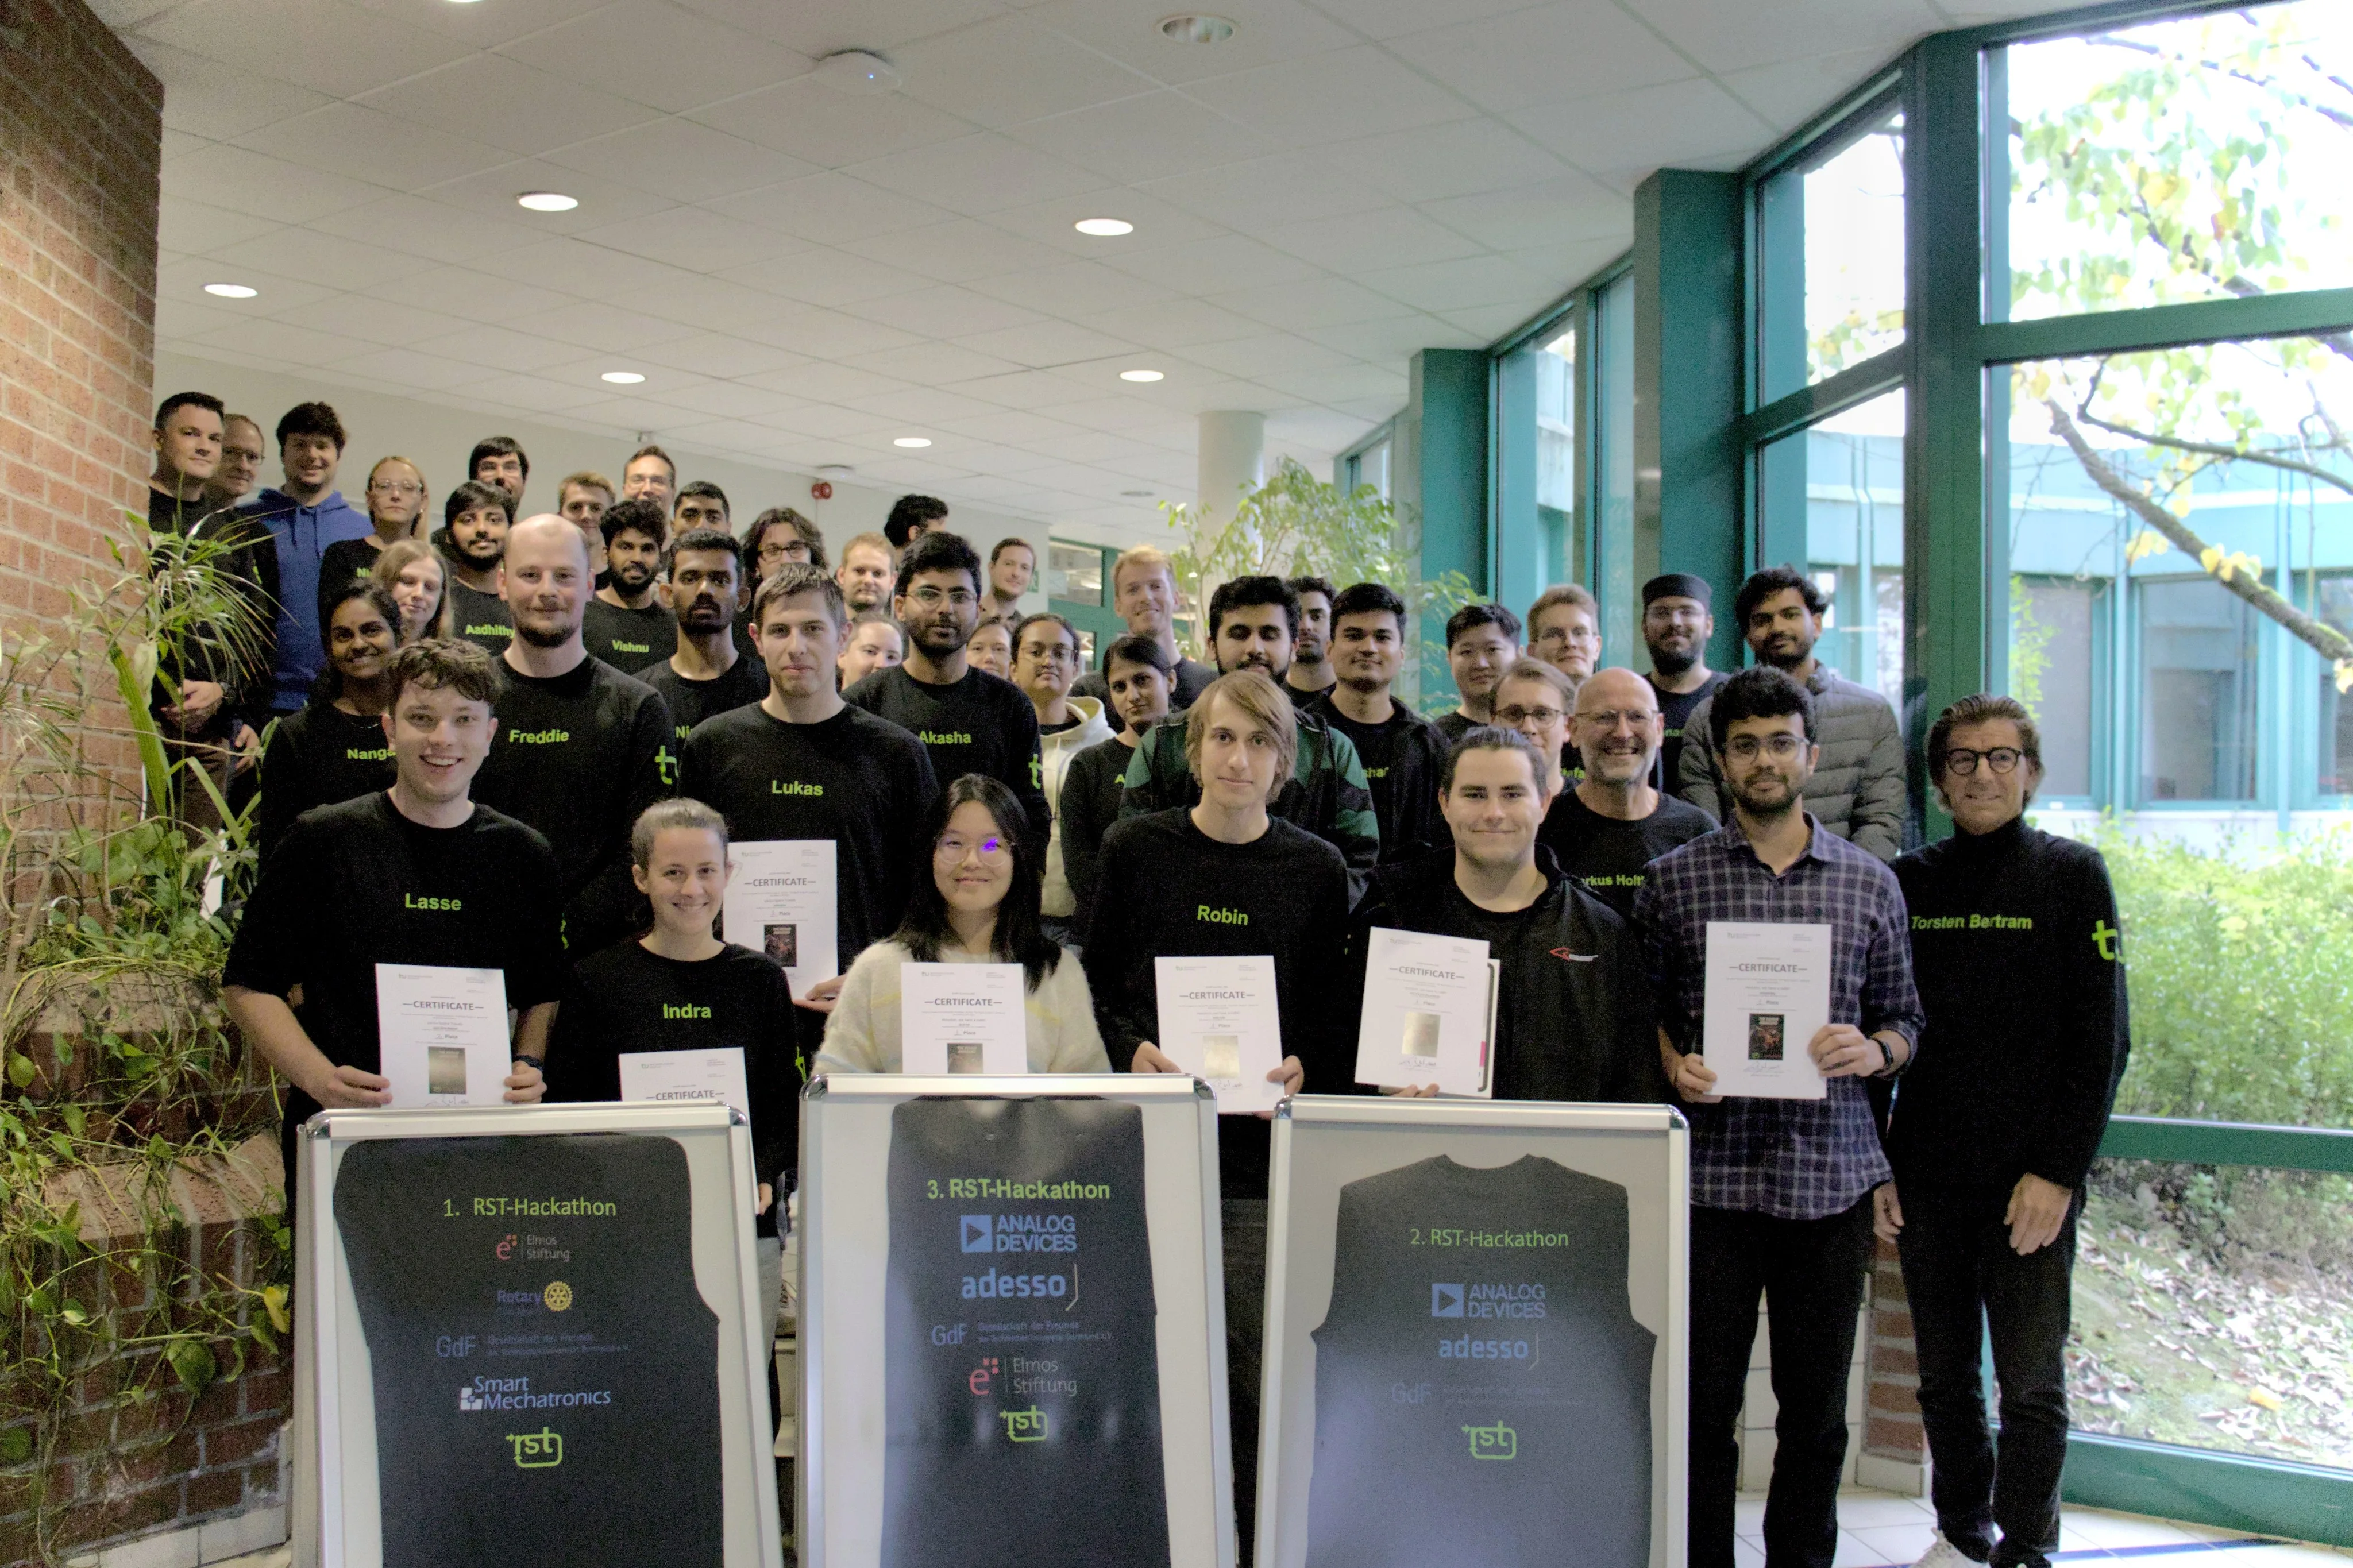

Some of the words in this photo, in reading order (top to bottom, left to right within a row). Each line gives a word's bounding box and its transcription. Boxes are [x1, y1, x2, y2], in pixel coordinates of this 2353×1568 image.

[465, 624, 515, 639] Aadhithy
[612, 640, 649, 653] Vishnu
[509, 729, 569, 744] Freddie
[919, 731, 971, 744] Akasha
[346, 748, 396, 760] Nanga
[772, 780, 824, 797] Lukas
[753, 878, 807, 887] CERTIFICATE
[405, 893, 461, 910] Lasse
[1197, 905, 1248, 925] Robin
[1912, 916, 1965, 930] Torsten
[1969, 913, 2032, 930] Bertram
[1398, 965, 1457, 980] CERTIFICATE
[1738, 963, 1798, 973] CERTIFICATE
[934, 998, 993, 1006] CERTIFICATE
[1189, 991, 1246, 999] CERTIFICATE
[413, 1001, 475, 1011] CERTIFICATE
[662, 1003, 711, 1019] Indra
[655, 1090, 715, 1101] CERTIFICATE
[928, 1179, 944, 1199] 3.
[950, 1179, 1110, 1199] RST-Hackathon
[443, 1199, 460, 1217] 1.
[473, 1196, 616, 1216] RST-Hackathon
[997, 1215, 1076, 1233] ANALOG
[527, 1234, 557, 1246] Elmos
[996, 1234, 1077, 1252] DEVICES
[1410, 1228, 1425, 1245] 2.
[1431, 1229, 1568, 1247] RST-Hackathon
[526, 1249, 570, 1262] Stiftung
[962, 1268, 1067, 1299] adesso
[1468, 1283, 1546, 1299] ANALOG
[497, 1289, 542, 1306] Rotary
[1468, 1301, 1546, 1318] DEVICES
[931, 1323, 967, 1346] GdF
[436, 1335, 477, 1358] GdF
[1439, 1333, 1529, 1359] adesso
[1013, 1358, 1058, 1373] Elmos
[474, 1376, 529, 1393] Smart
[1013, 1378, 1077, 1397] Stiftung
[1391, 1382, 1431, 1404] GdF
[484, 1390, 611, 1410] Mechatronics
